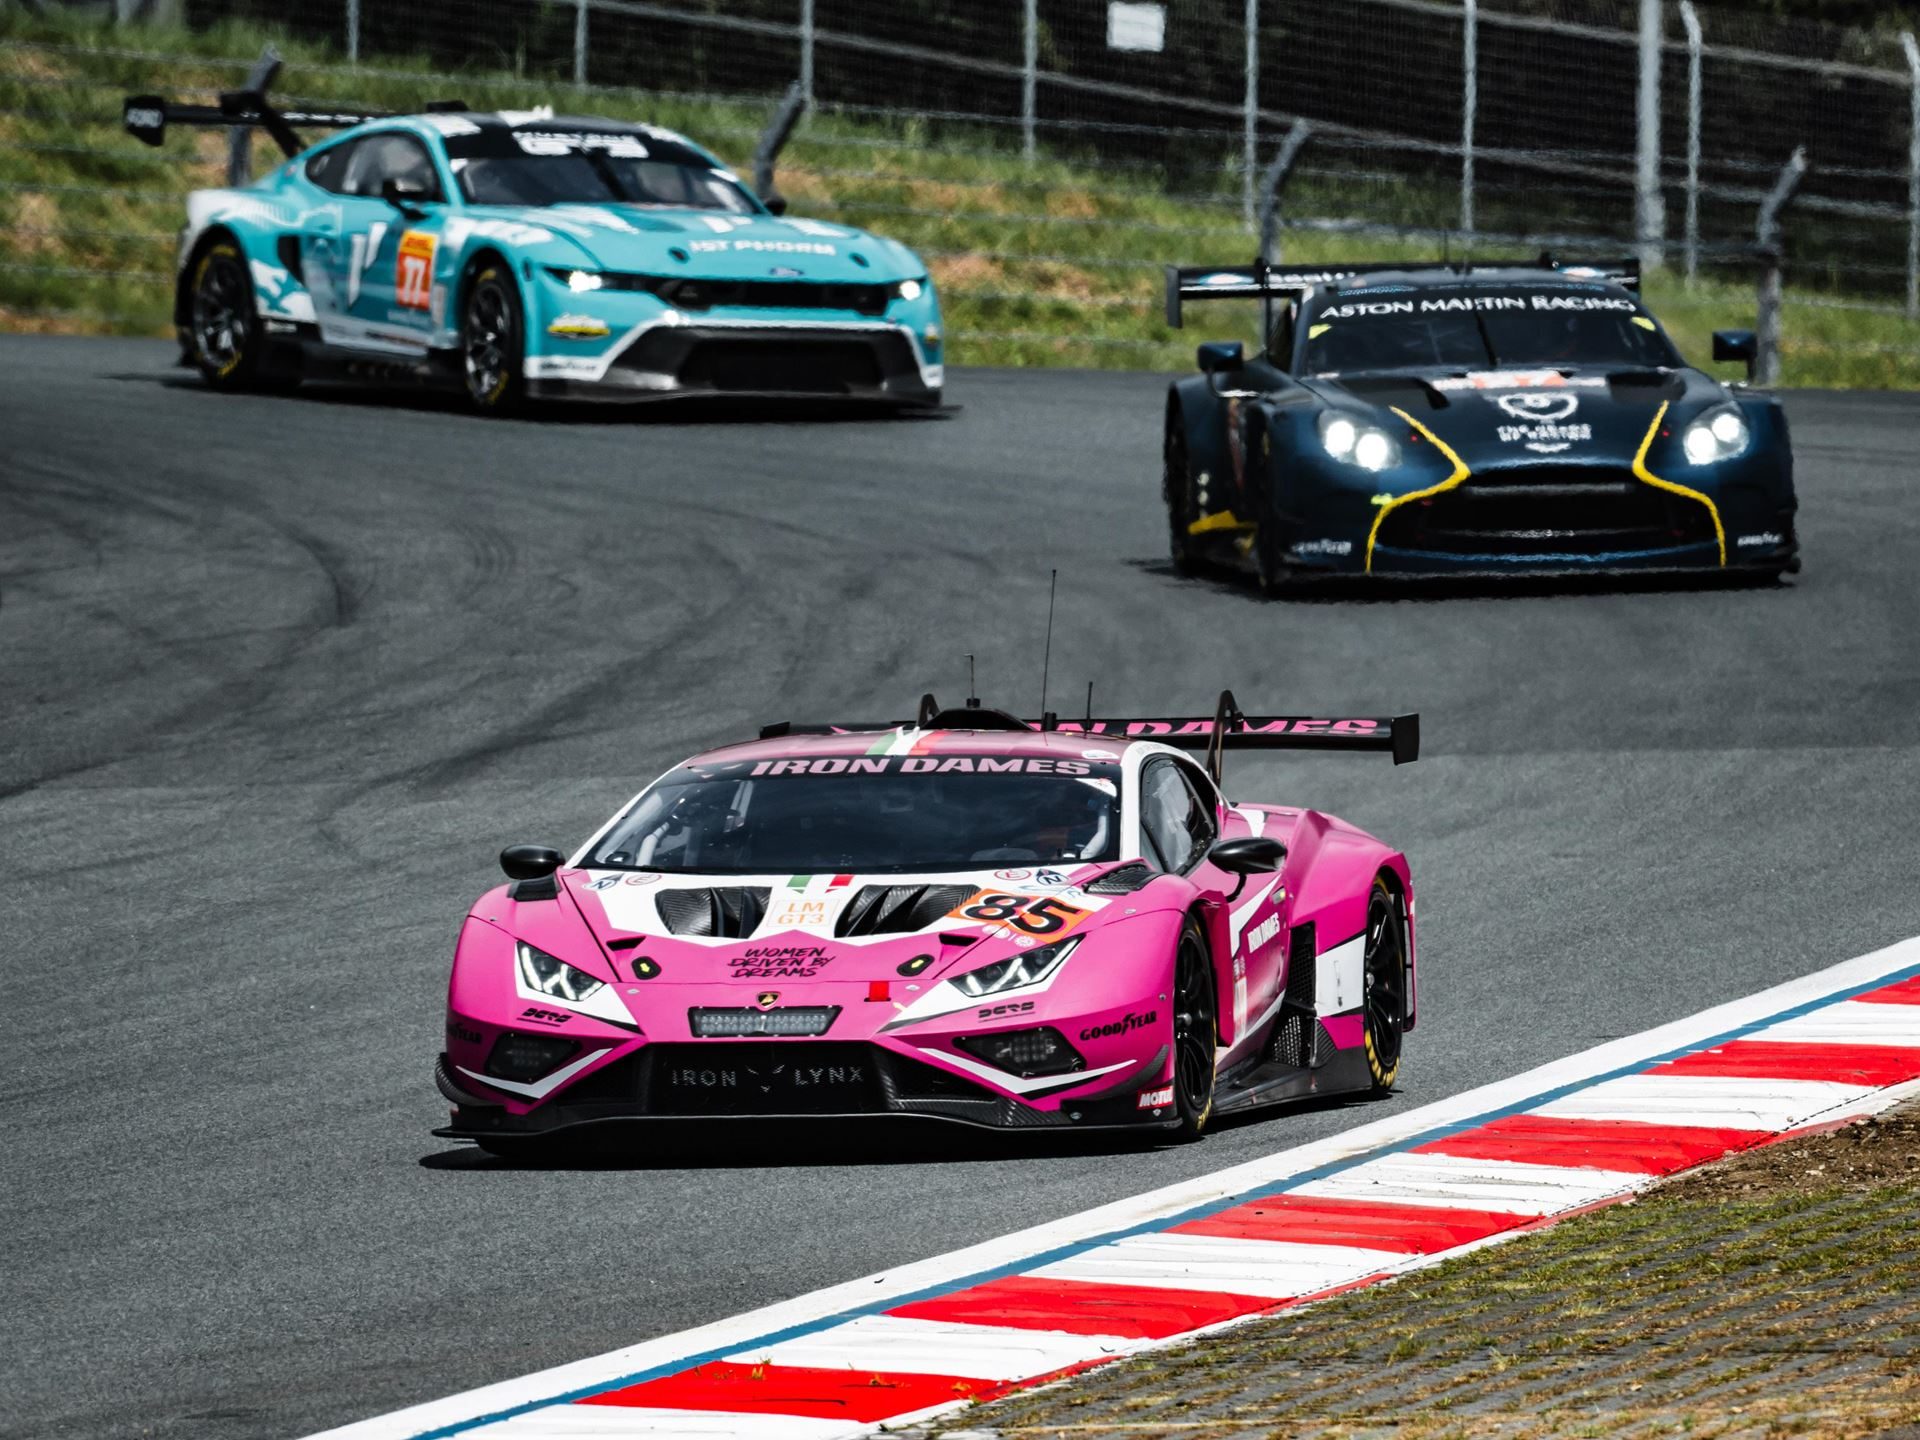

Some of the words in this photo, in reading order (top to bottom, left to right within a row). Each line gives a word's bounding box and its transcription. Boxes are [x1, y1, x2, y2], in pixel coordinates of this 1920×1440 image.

[1319, 300, 1414, 319] ASTON
[1530, 295, 1637, 312] RACING
[750, 758, 891, 776] IRON
[900, 758, 1091, 776] DAMES
[787, 902, 825, 913] LM
[963, 894, 1082, 935] 85
[777, 914, 825, 925] GT3
[744, 947, 827, 958] WOMEN
[727, 958, 805, 968] DRIVEN
[808, 956, 836, 968] BY
[730, 967, 819, 978] DREAMS
[1079, 1010, 1158, 1041] GOODYEAR
[672, 1069, 736, 1086] IRON
[795, 1066, 863, 1086] LYNX
